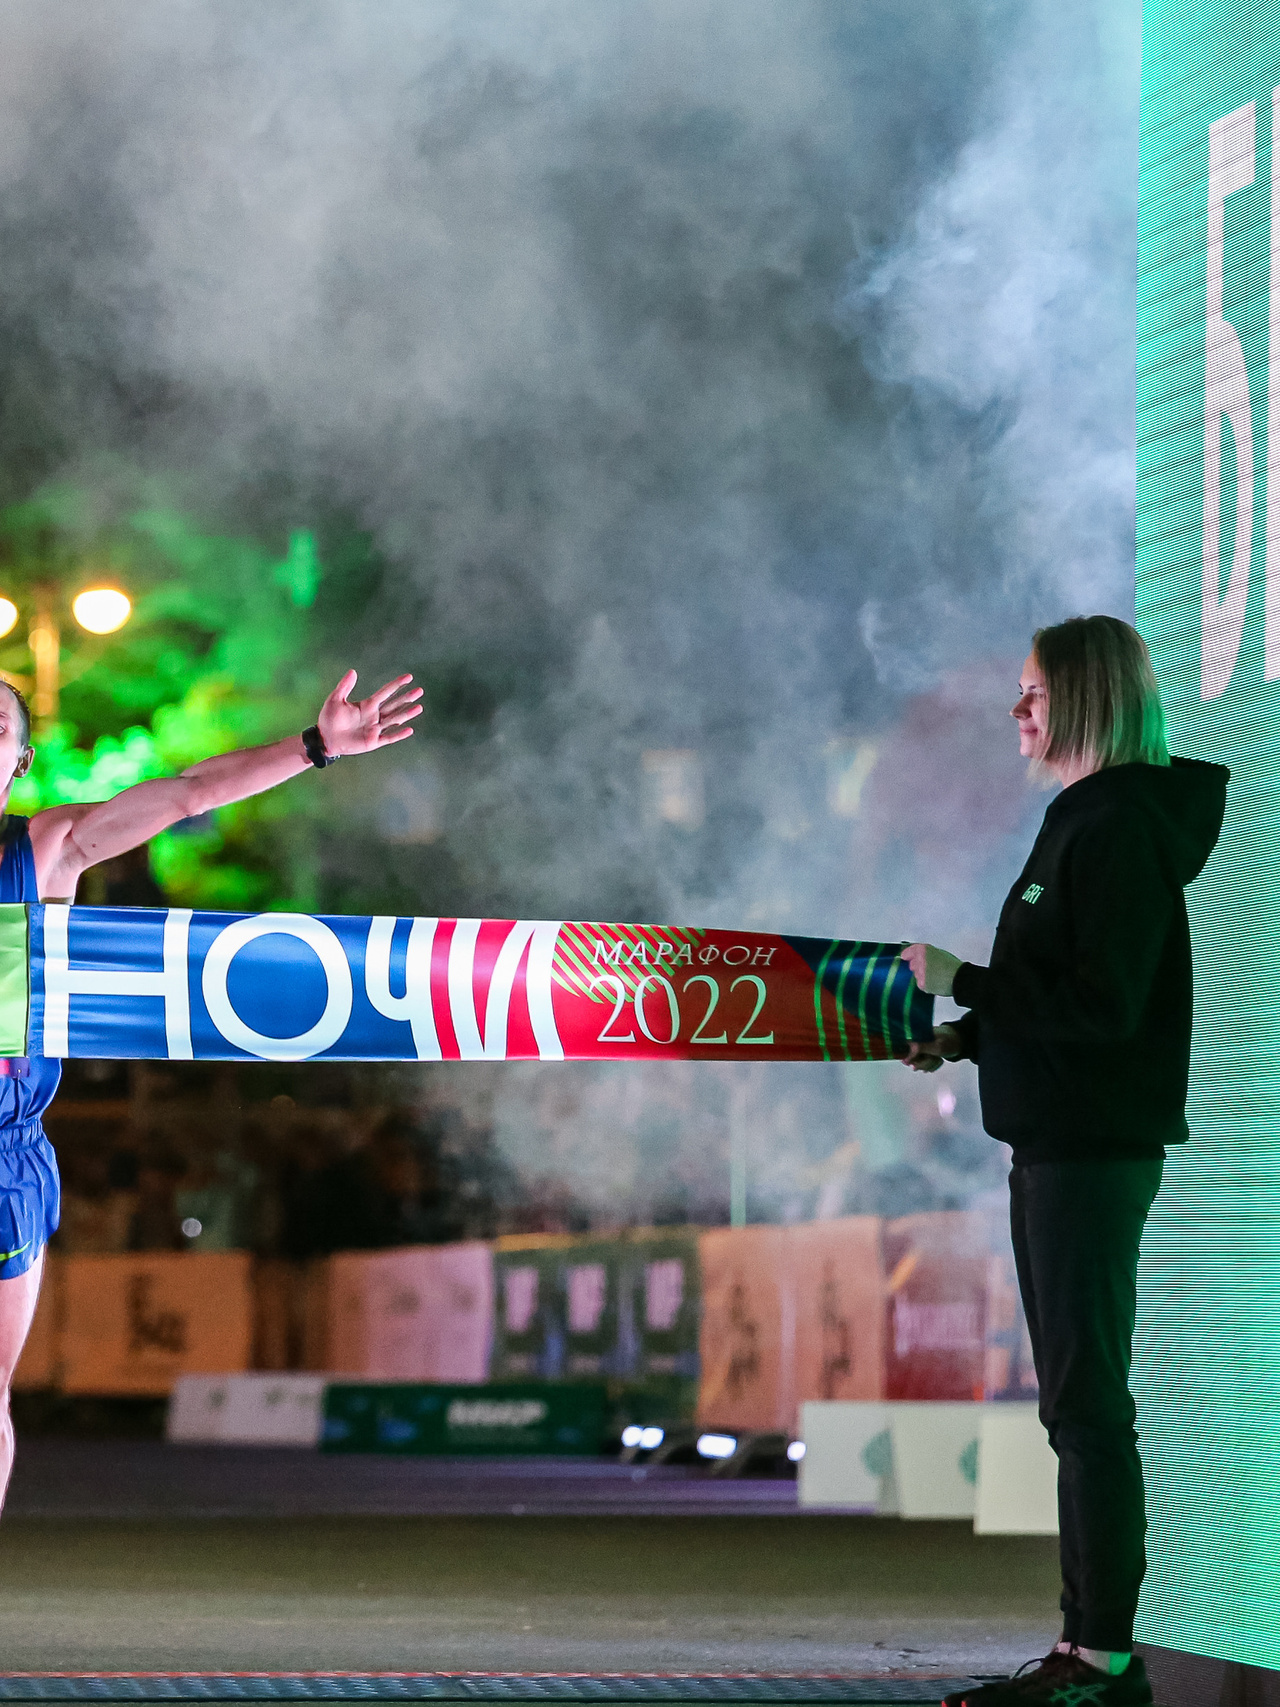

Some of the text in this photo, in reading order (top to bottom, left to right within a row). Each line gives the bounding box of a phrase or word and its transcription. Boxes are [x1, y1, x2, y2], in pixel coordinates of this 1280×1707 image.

[43, 903, 565, 1062] НОЧИ
[590, 939, 779, 966] МАРАФОН
[588, 974, 775, 1044] 2022
